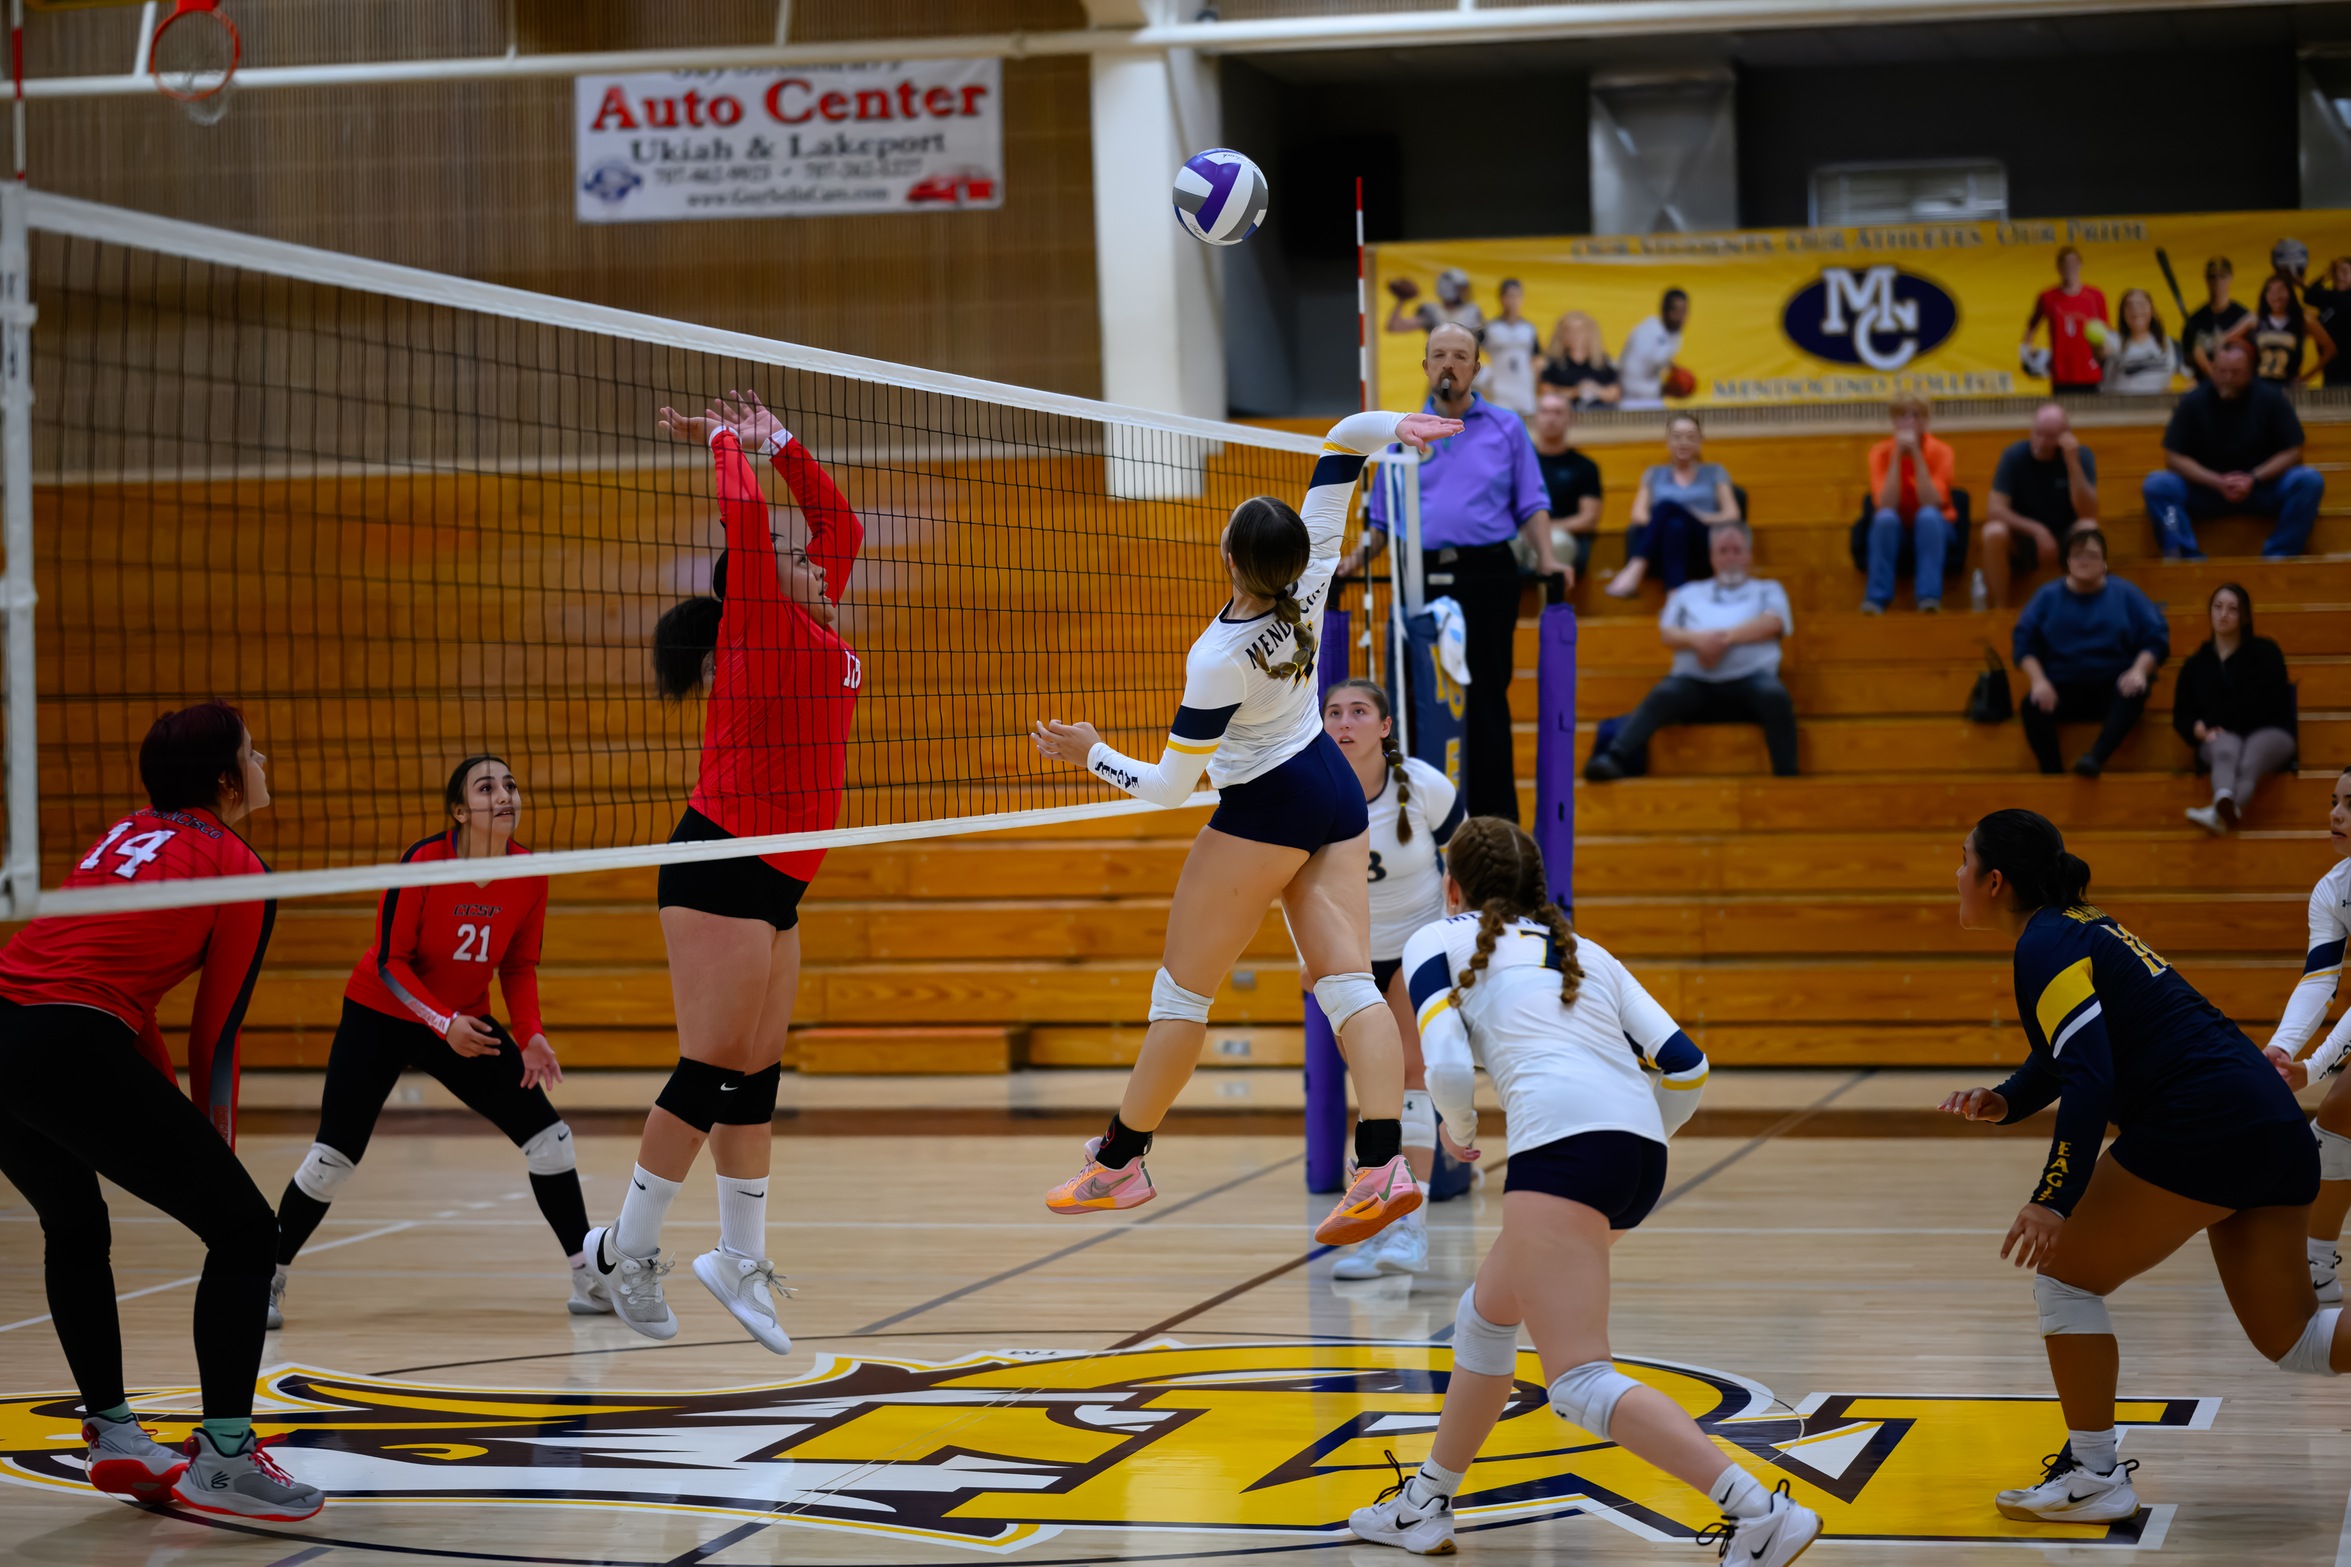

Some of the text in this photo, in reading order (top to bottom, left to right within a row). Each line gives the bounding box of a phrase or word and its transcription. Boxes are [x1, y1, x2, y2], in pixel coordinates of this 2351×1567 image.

[592, 77, 986, 130] Auto Center
[631, 133, 945, 164] Ukiah & Lakeport
[1821, 266, 1919, 371] MC
[1095, 761, 1140, 789] EAGLES
[79, 820, 179, 880] 14
[453, 923, 491, 963] 21
